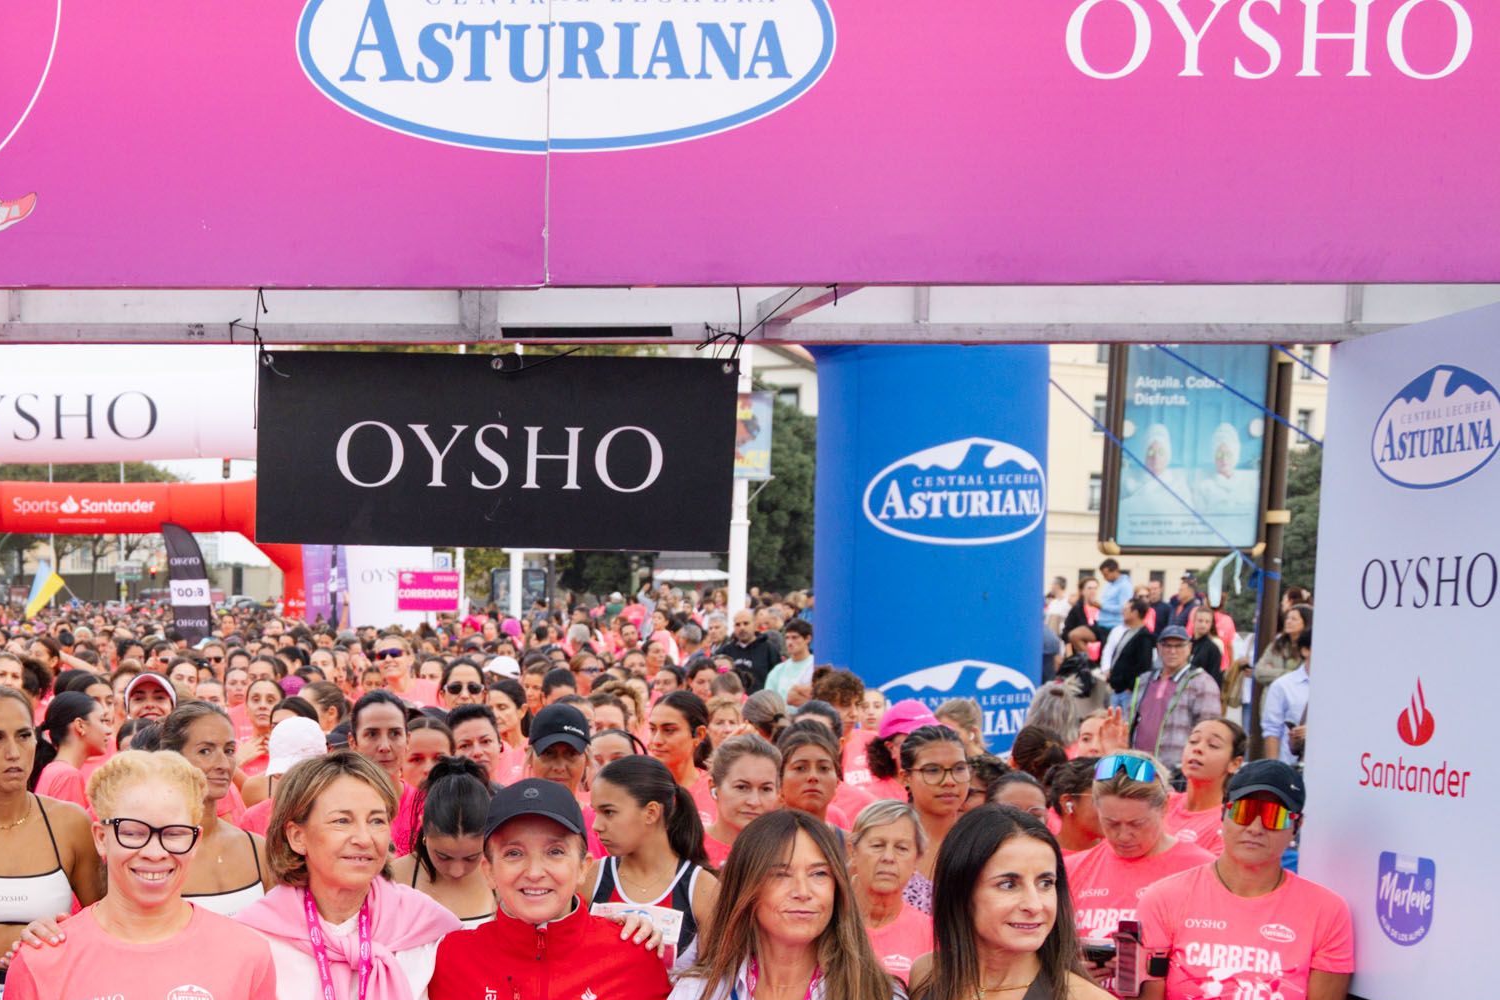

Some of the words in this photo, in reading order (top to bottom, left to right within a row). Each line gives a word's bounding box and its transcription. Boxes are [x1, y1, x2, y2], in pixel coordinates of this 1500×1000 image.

[340, 0, 793, 83] ASTURIANA
[1065, 0, 1473, 80] OYSHO
[335, 420, 664, 493] OYSHO
[1379, 418, 1494, 462] ASTURIANA
[878, 480, 1041, 519] ASTURIANA
[912, 474, 984, 488] CENTRAL
[13, 496, 58, 515] Sports
[80, 497, 155, 513] Santander
[1361, 552, 1498, 610] OYSHO
[1359, 752, 1471, 798] Santander
[1379, 872, 1431, 918] Marlene
[1185, 918, 1227, 930] OYSHO
